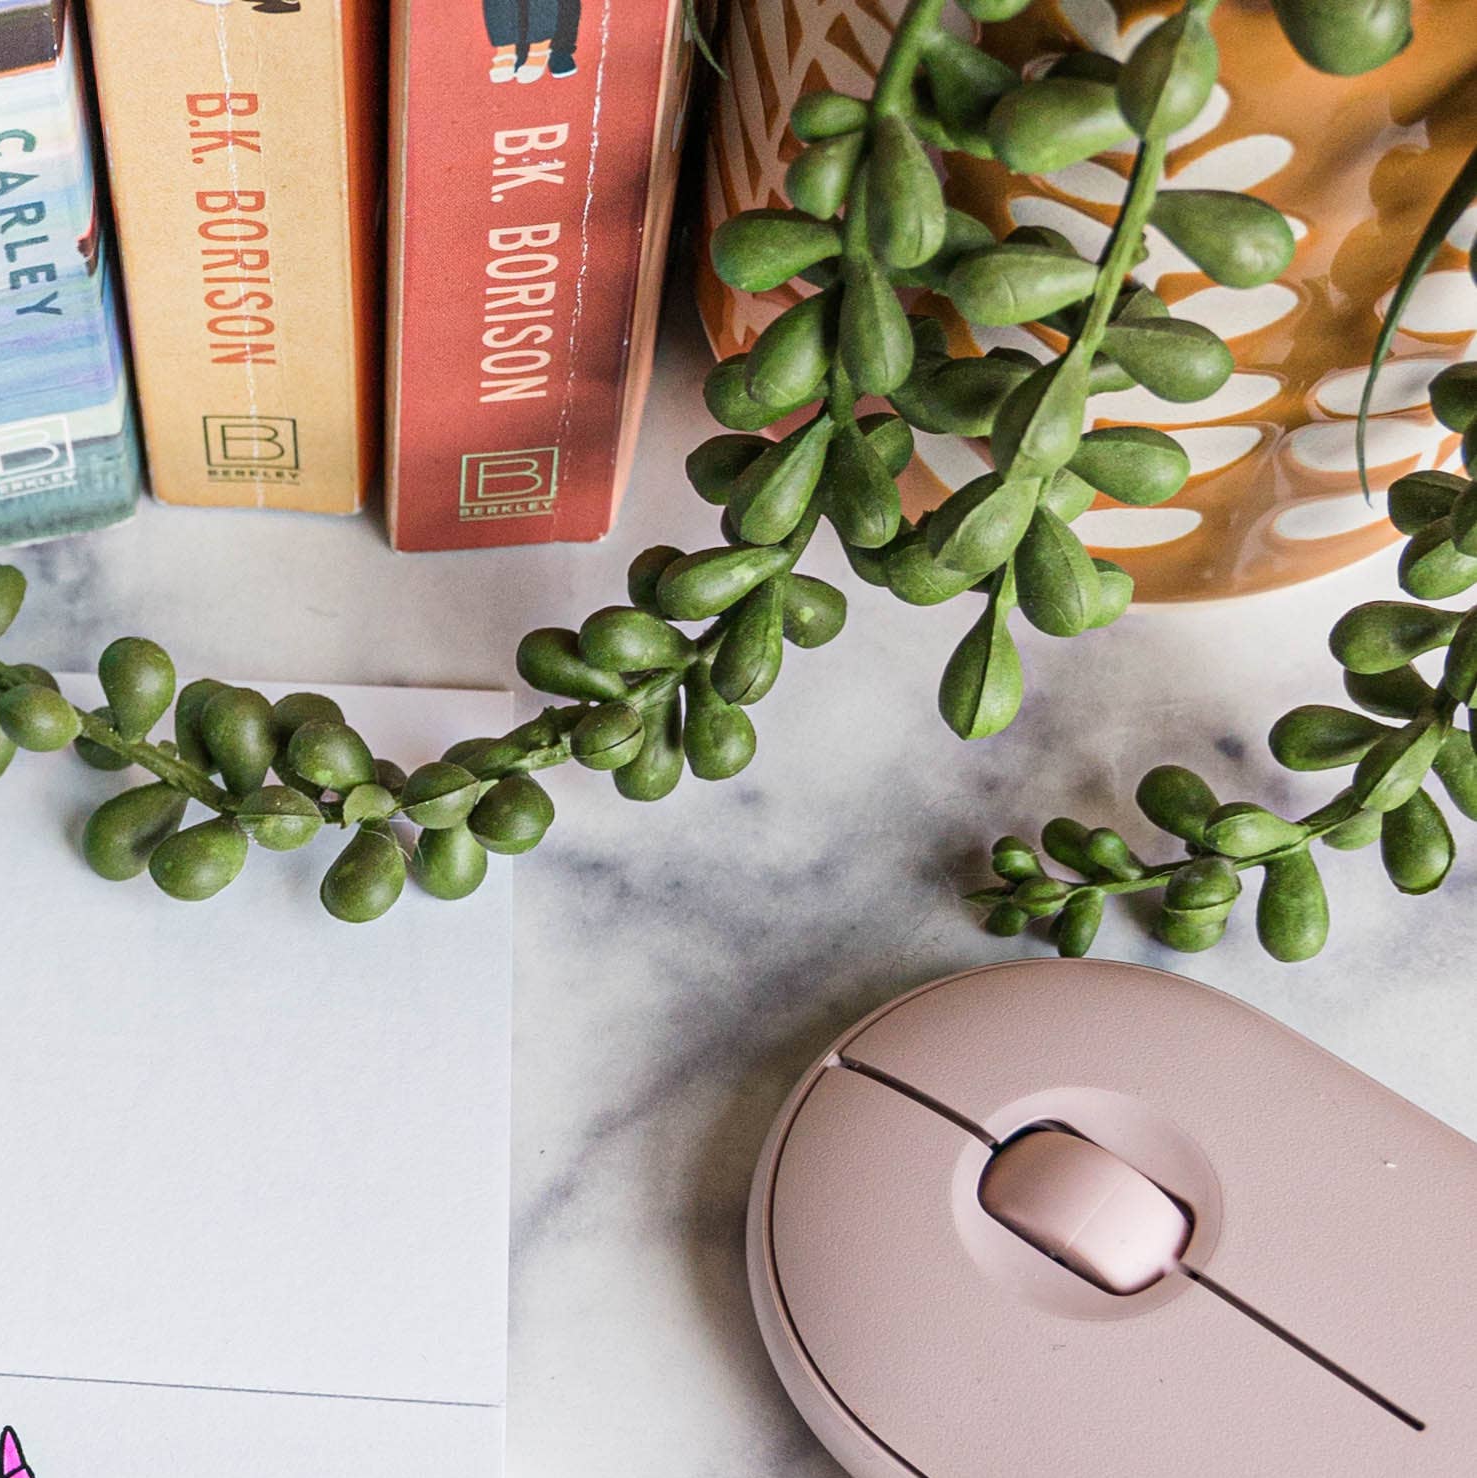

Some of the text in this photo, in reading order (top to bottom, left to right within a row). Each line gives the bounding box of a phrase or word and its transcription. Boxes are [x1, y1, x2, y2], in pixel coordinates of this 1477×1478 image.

[186, 93, 276, 364] B.K. BORISON
[479, 123, 569, 403] B.K. BORISON
[459, 501, 552, 516] BERKLEY
